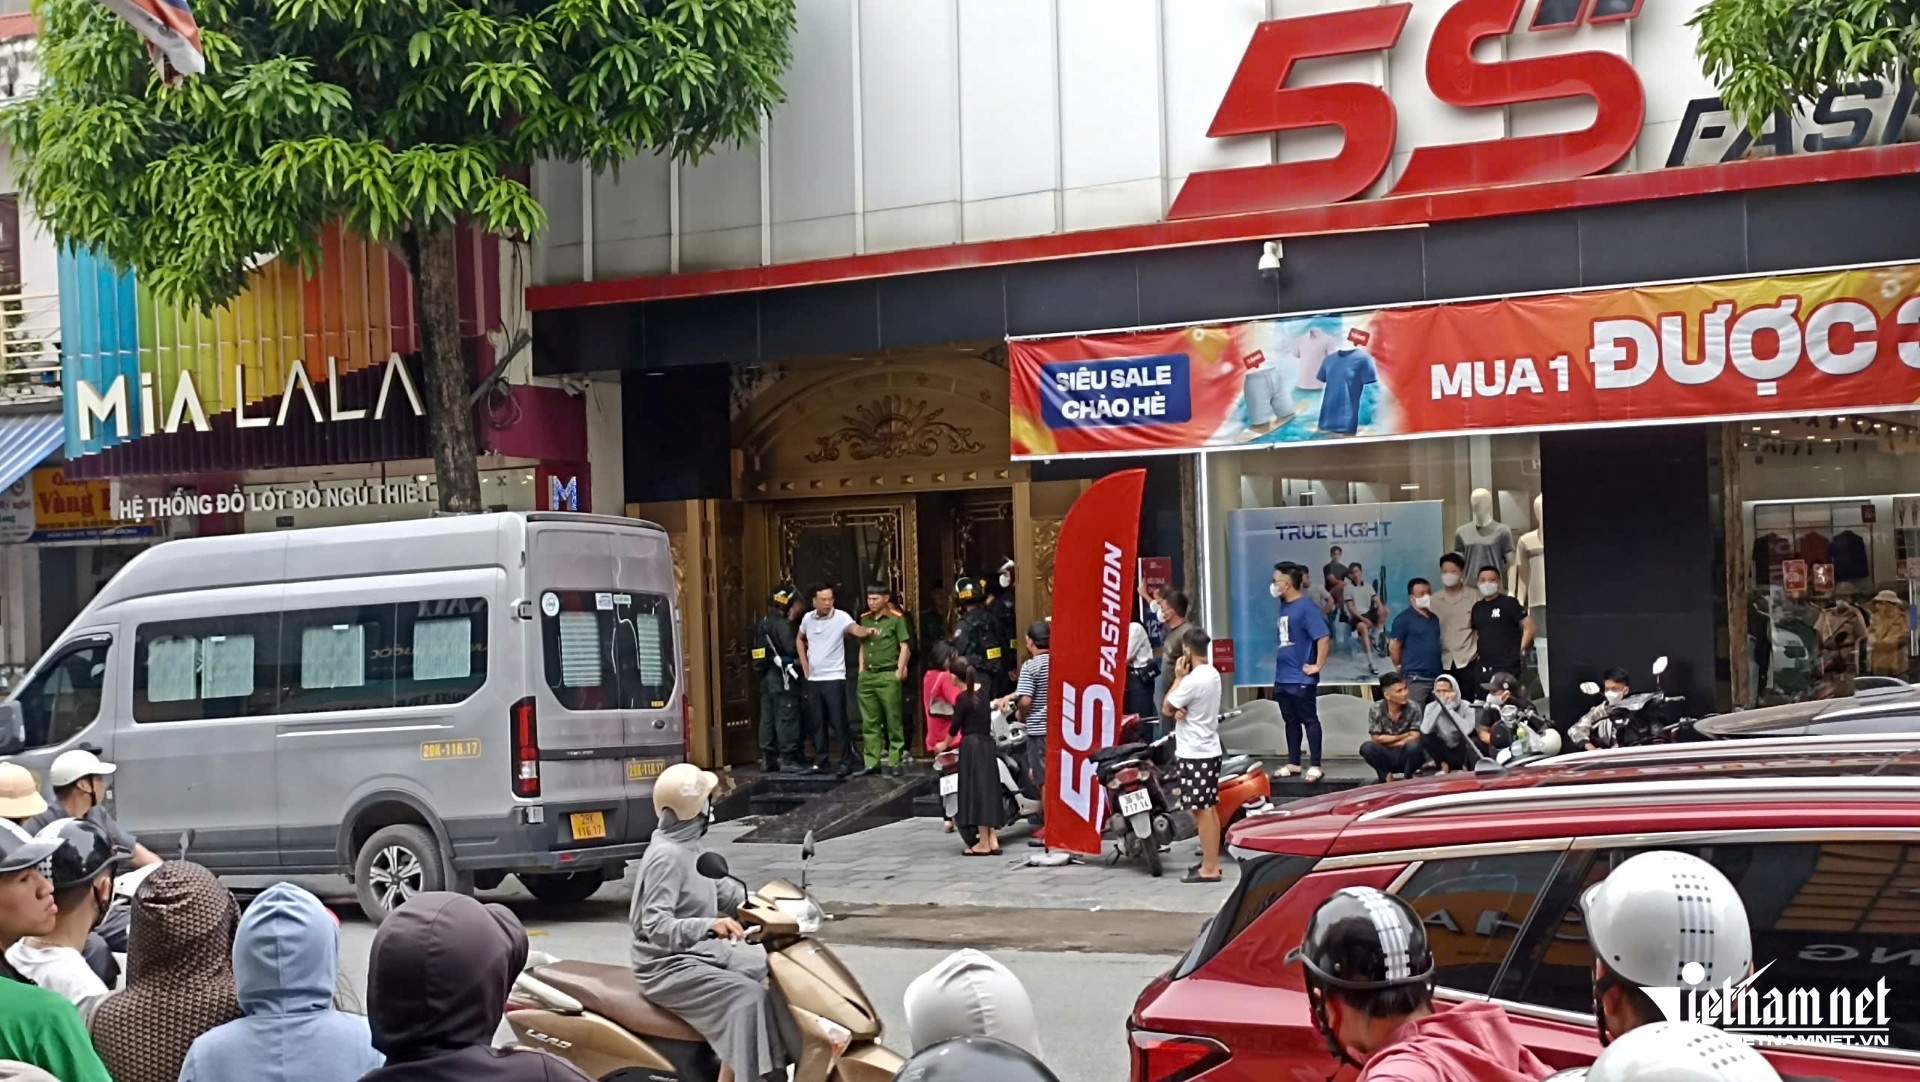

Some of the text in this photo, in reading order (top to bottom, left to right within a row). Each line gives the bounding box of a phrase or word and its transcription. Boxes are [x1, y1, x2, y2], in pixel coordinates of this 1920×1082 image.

[1430, 357, 1540, 400] MUA
[1548, 355, 1569, 392] 1
[1588, 297, 1879, 396] ĐƯỢC
[235, 352, 426, 428] LALA
[1056, 364, 1172, 392] SIÊU SALE
[1061, 391, 1166, 420] CHÀO HÈ
[120, 494, 145, 523] HỆ
[147, 487, 213, 518] THỐNG
[216, 484, 245, 514] ĐỒ
[548, 474, 578, 511] M
[1275, 520, 1393, 541] TRUE LIGHT
[1099, 541, 1123, 683] FASHION
[525, 1028, 573, 1050] LEAD
